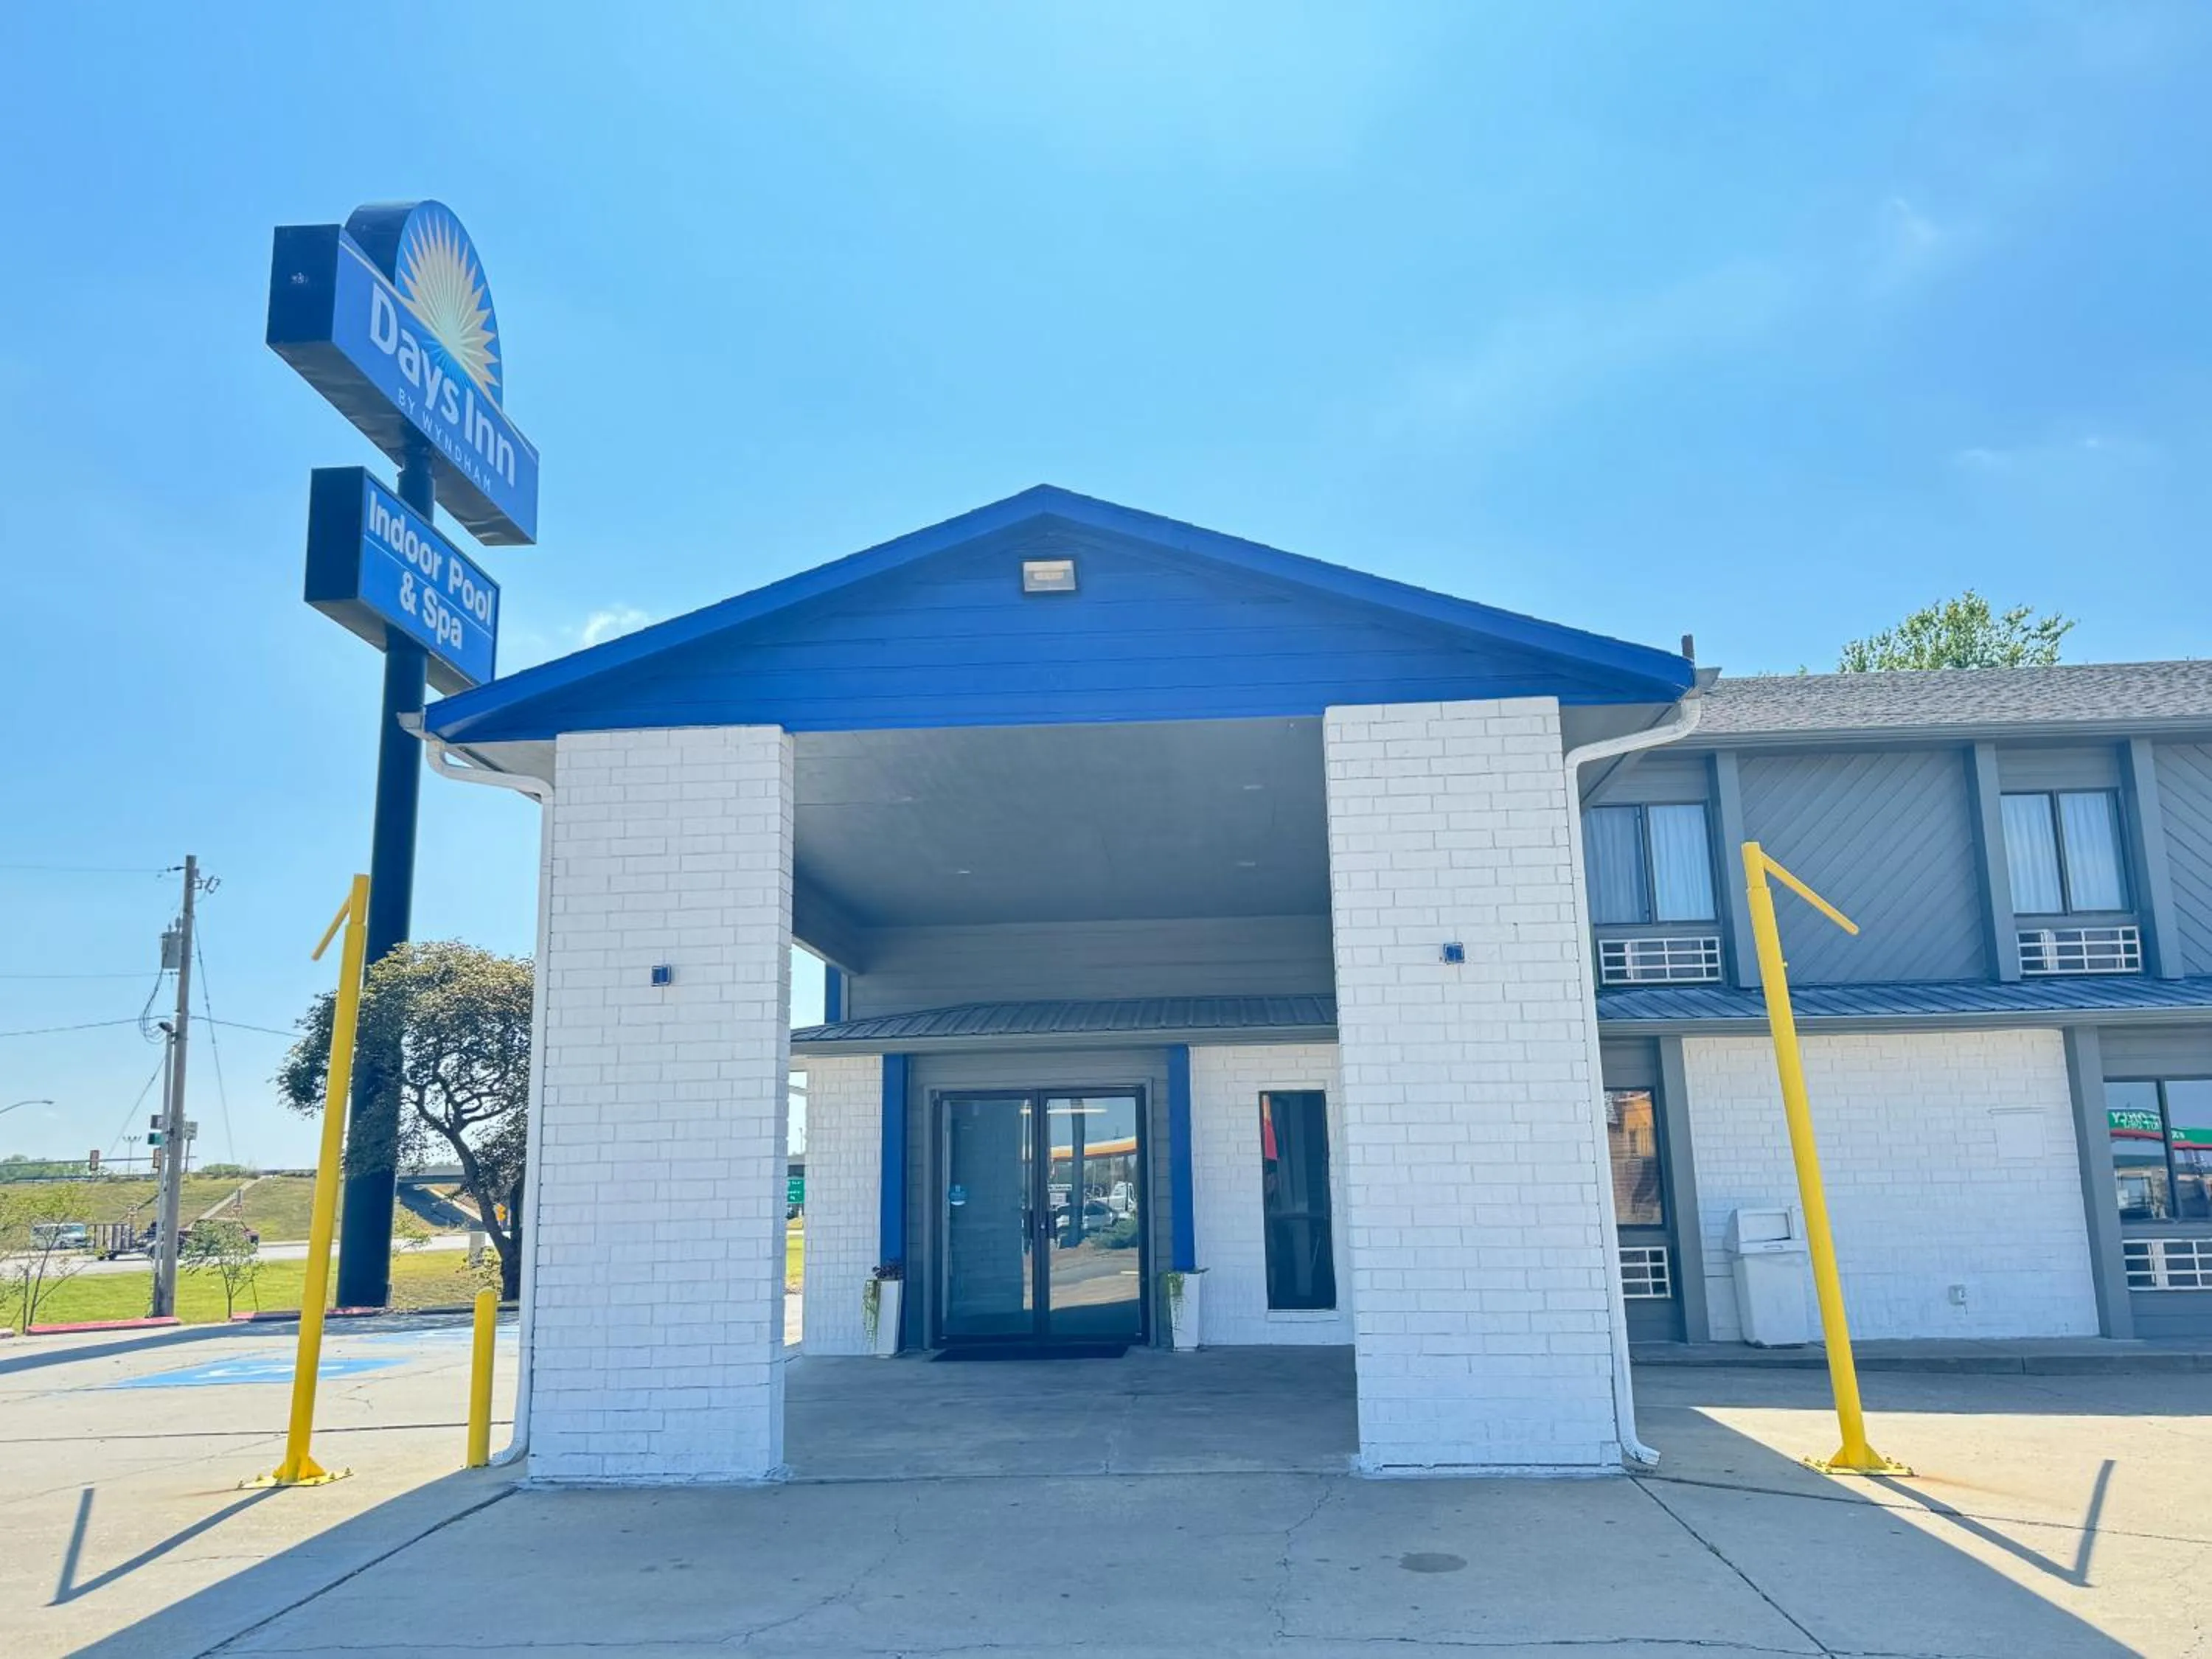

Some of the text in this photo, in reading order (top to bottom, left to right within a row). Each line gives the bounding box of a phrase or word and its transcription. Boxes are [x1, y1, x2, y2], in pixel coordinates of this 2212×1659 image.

[370, 282, 515, 488] Days Inn
[397, 386, 491, 493] BY WYNDHAM
[369, 490, 493, 626] Indoor Pool
[400, 571, 462, 650] & Spa
